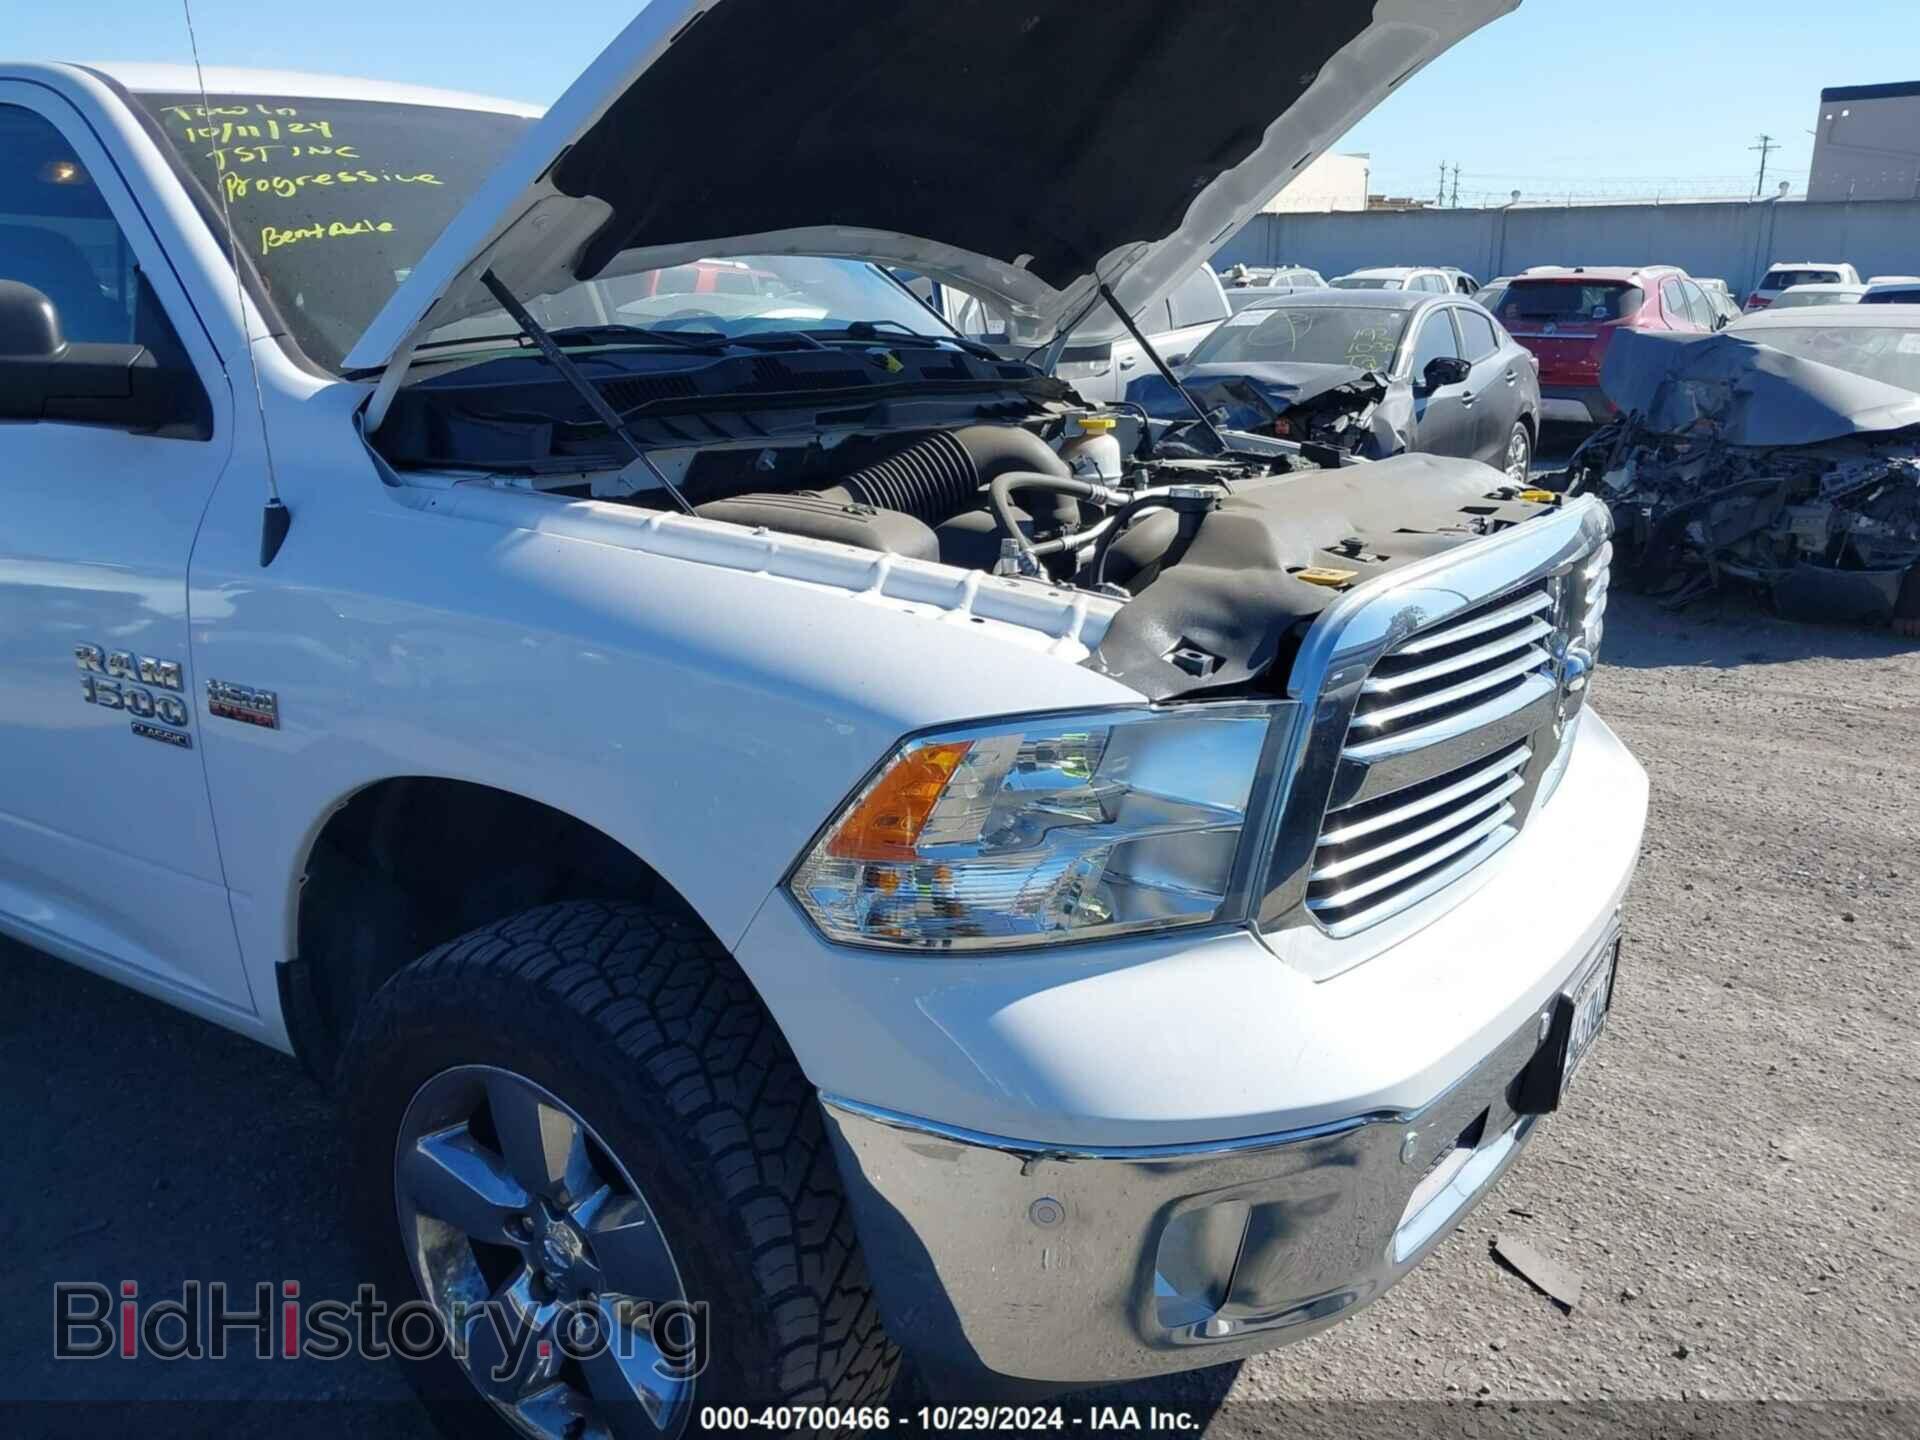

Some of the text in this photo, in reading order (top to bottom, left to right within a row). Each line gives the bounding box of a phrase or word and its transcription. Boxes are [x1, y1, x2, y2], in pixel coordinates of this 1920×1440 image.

[185, 119, 333, 144] 10/11/24
[222, 169, 445, 203] Progressive
[74, 641, 184, 693] RAM
[80, 673, 188, 727] 1500
